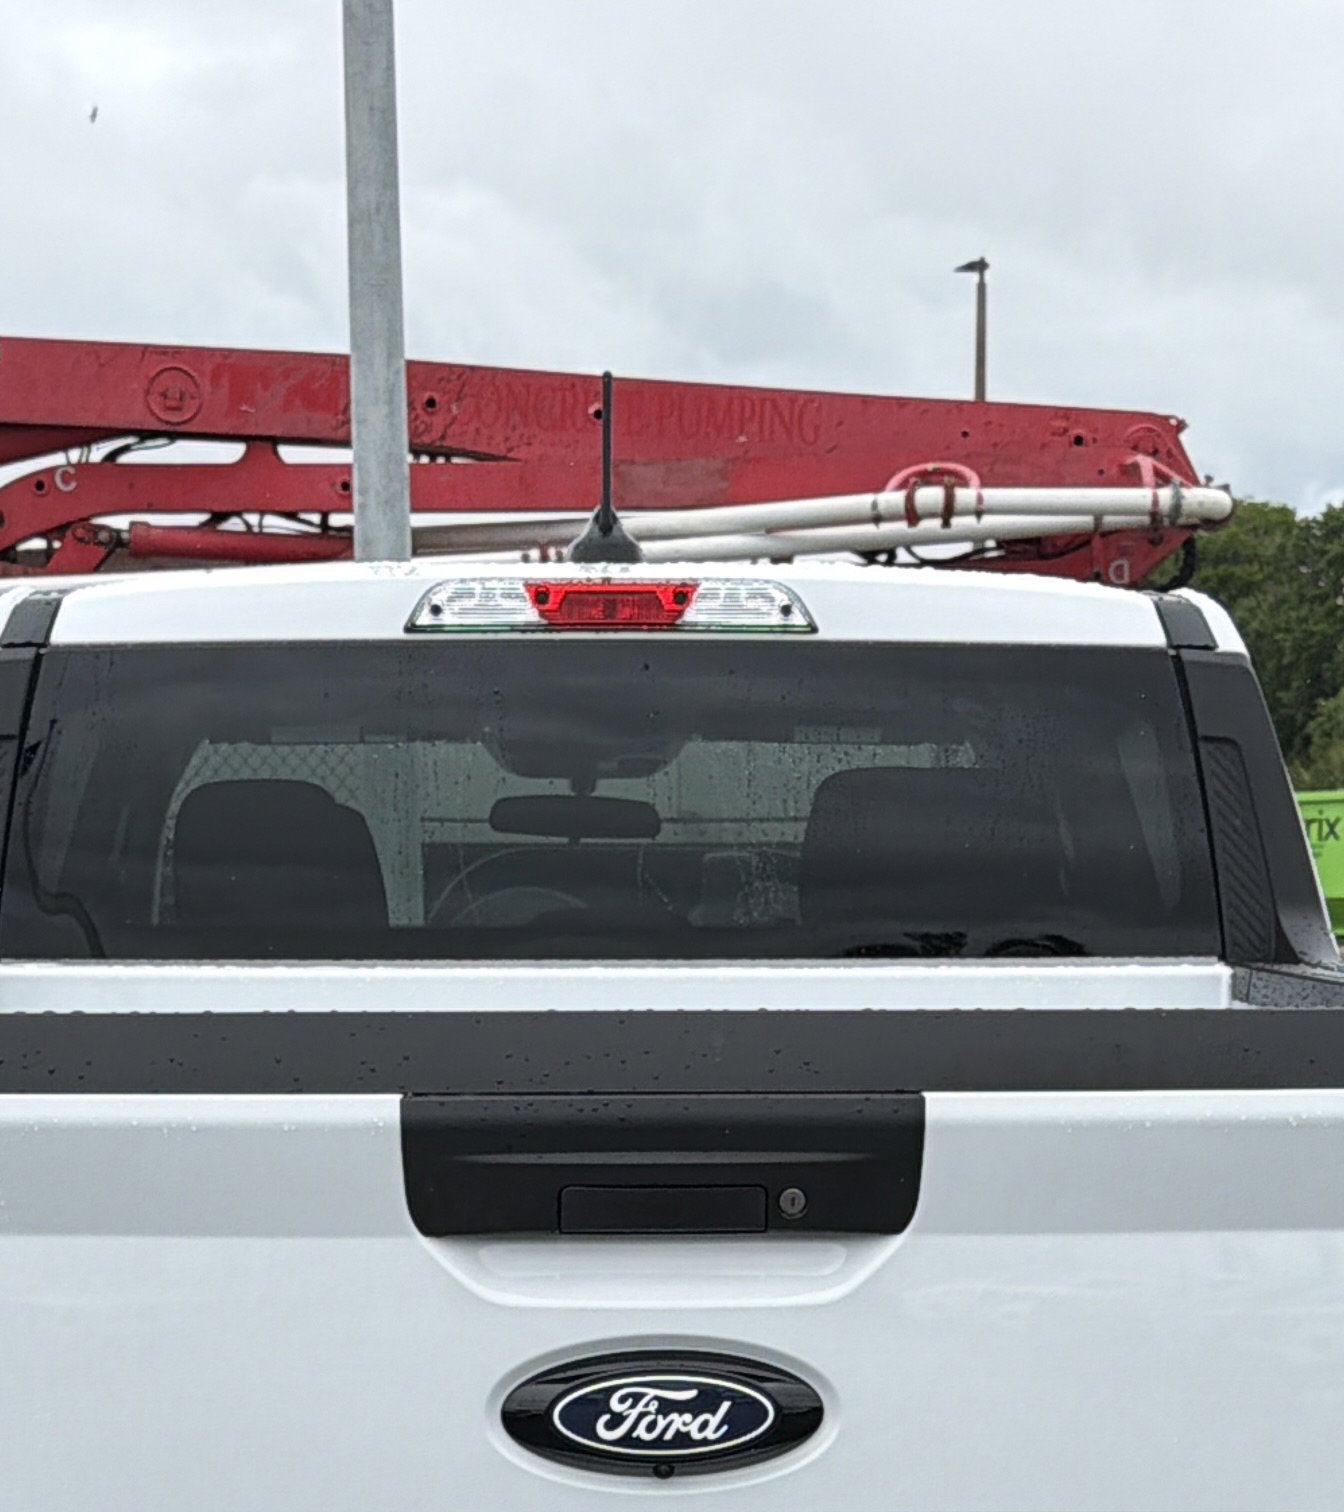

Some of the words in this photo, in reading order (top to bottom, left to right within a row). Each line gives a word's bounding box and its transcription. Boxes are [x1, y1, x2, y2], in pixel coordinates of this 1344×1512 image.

[454, 379, 651, 438] CONCREE
[658, 392, 821, 445] PUMPING
[54, 466, 77, 492] C
[595, 1386, 732, 1442] Ford
